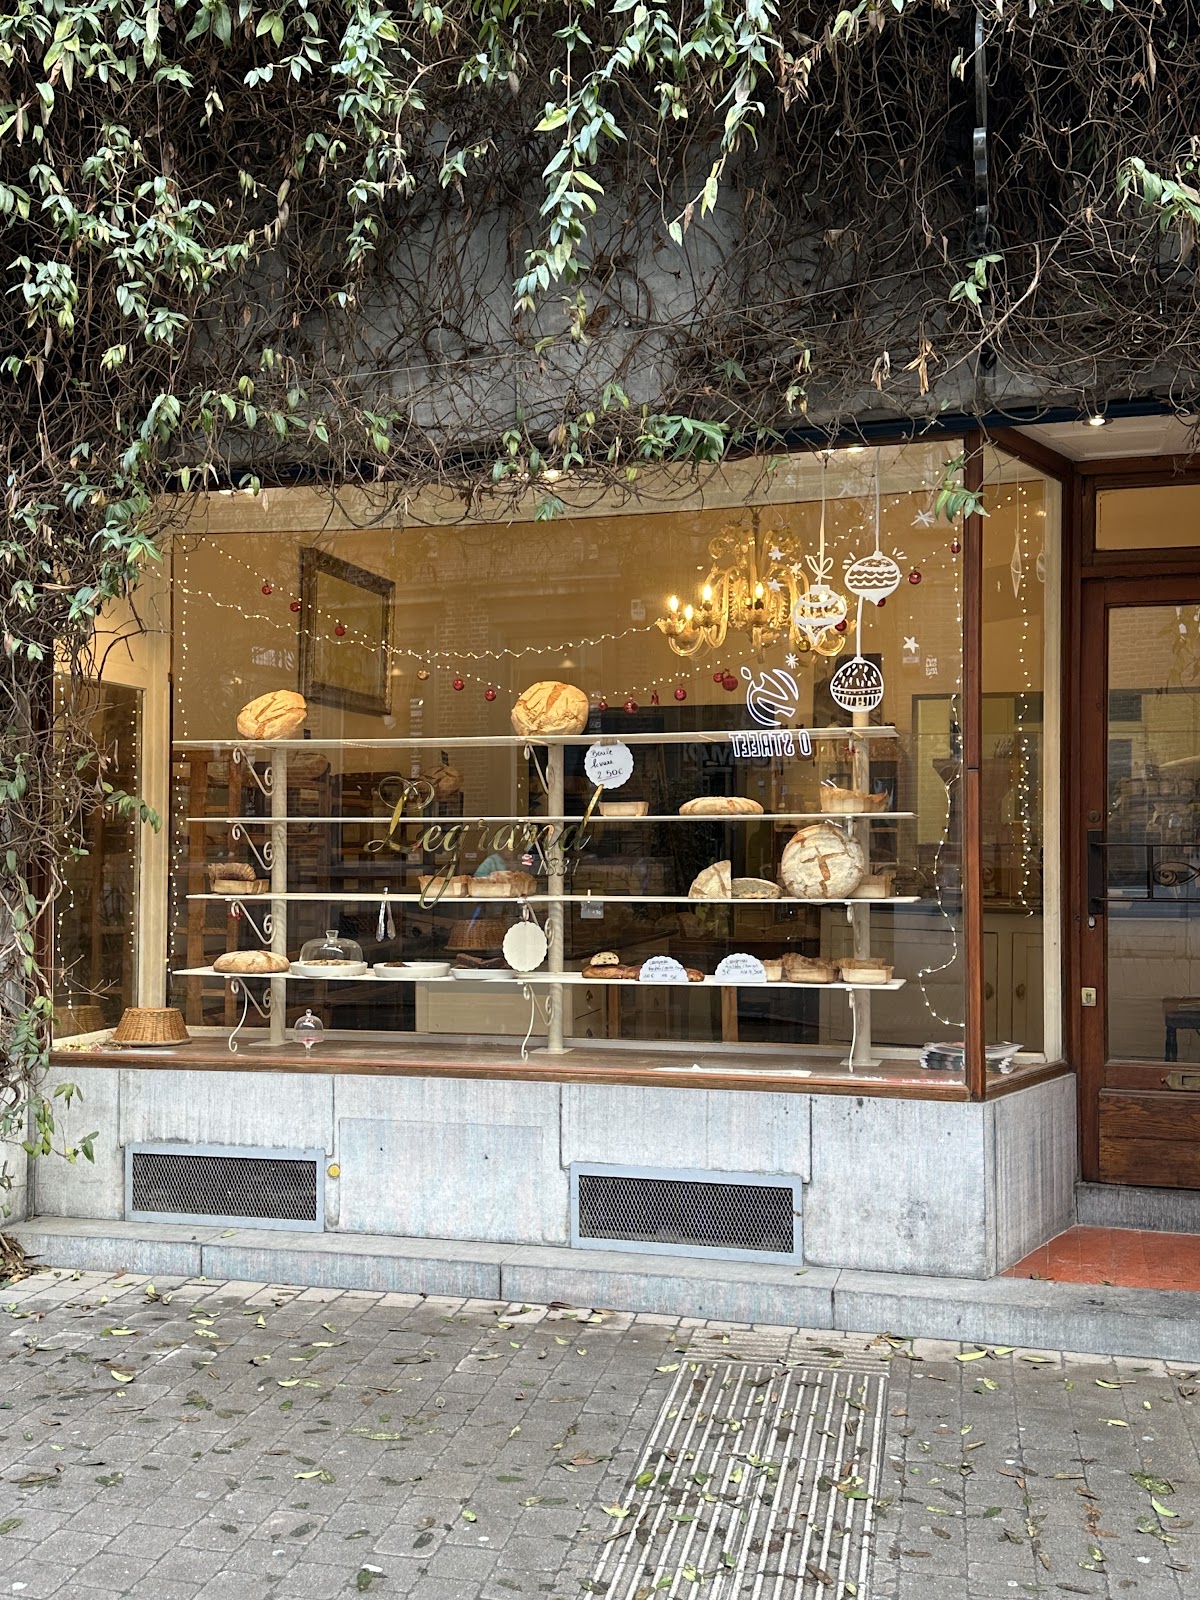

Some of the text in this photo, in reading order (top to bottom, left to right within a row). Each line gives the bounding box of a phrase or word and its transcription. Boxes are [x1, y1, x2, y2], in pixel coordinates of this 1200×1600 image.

[590, 747, 613, 758] Boule
[364, 776, 604, 910] Legrand
[537, 857, 580, 877] 1831
